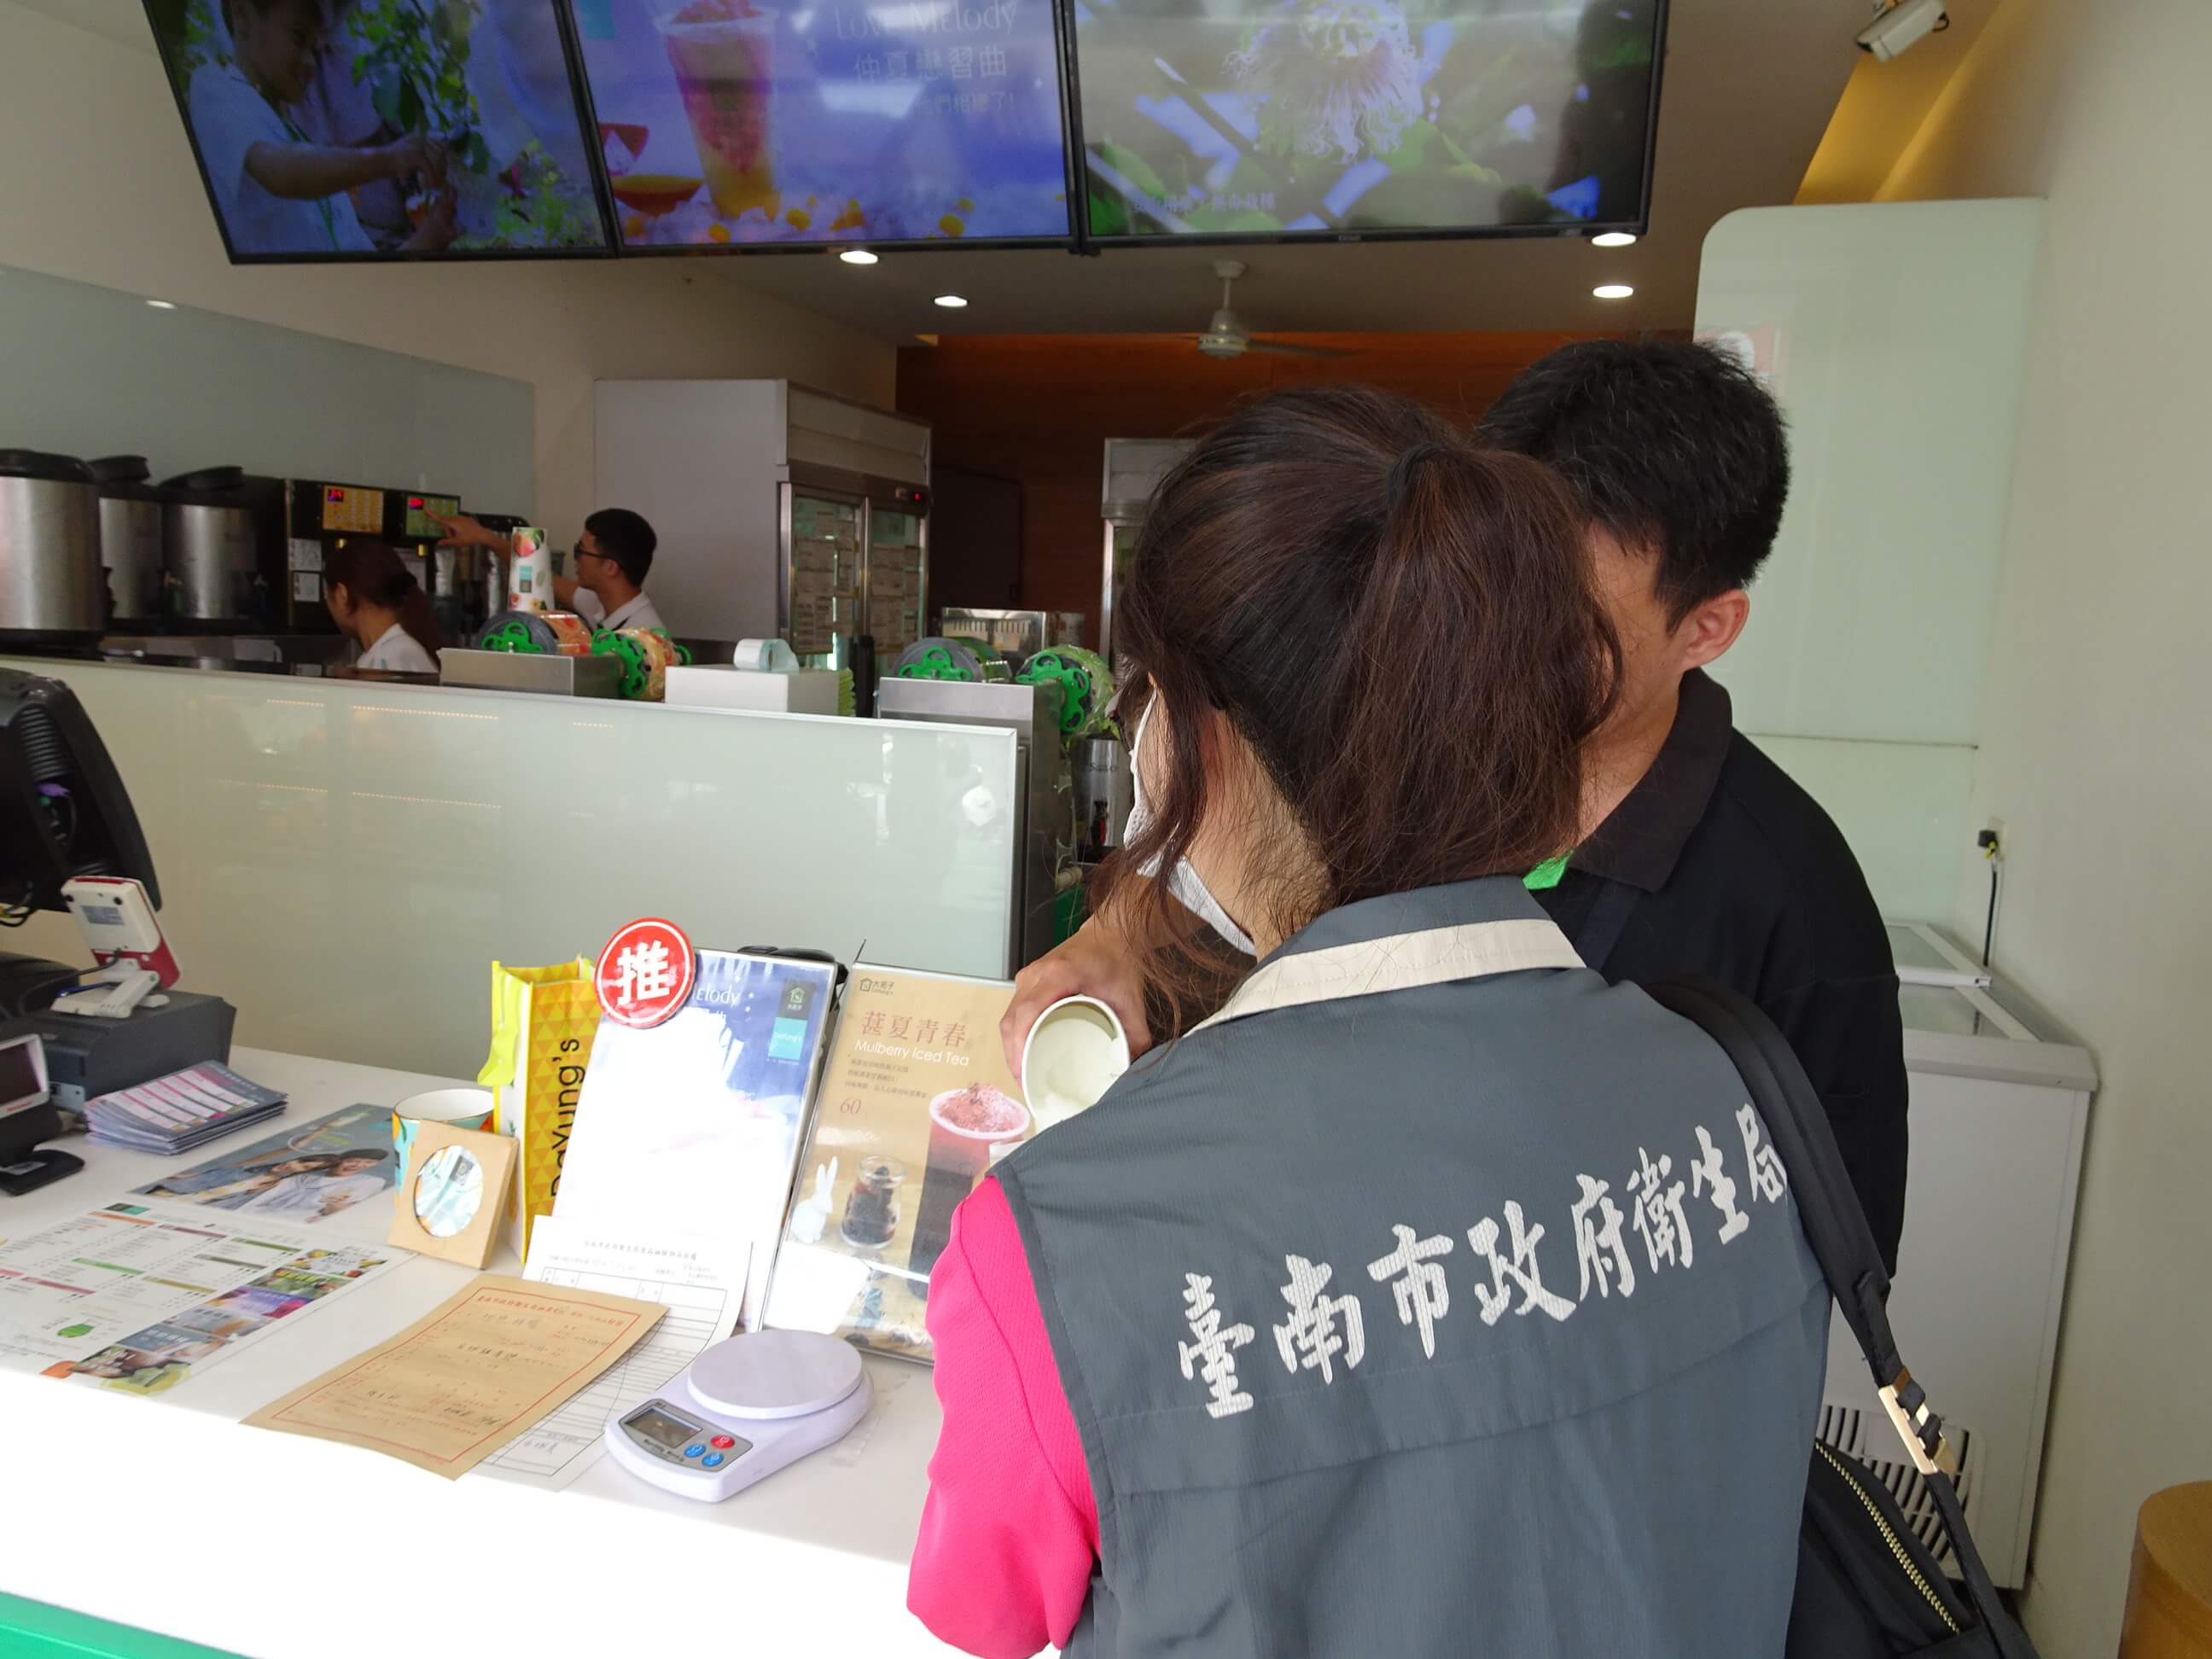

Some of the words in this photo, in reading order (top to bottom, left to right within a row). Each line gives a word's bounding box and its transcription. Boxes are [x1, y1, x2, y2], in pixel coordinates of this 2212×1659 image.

[616, 940, 670, 1005] 推
[693, 982, 742, 1008] elody
[854, 1039, 911, 1060] Mulberry
[912, 1047, 943, 1062] Iced
[946, 1051, 969, 1066] Tea
[840, 1097, 861, 1114] 60
[1179, 1103, 1788, 1419] 臺南市政府衛生局
